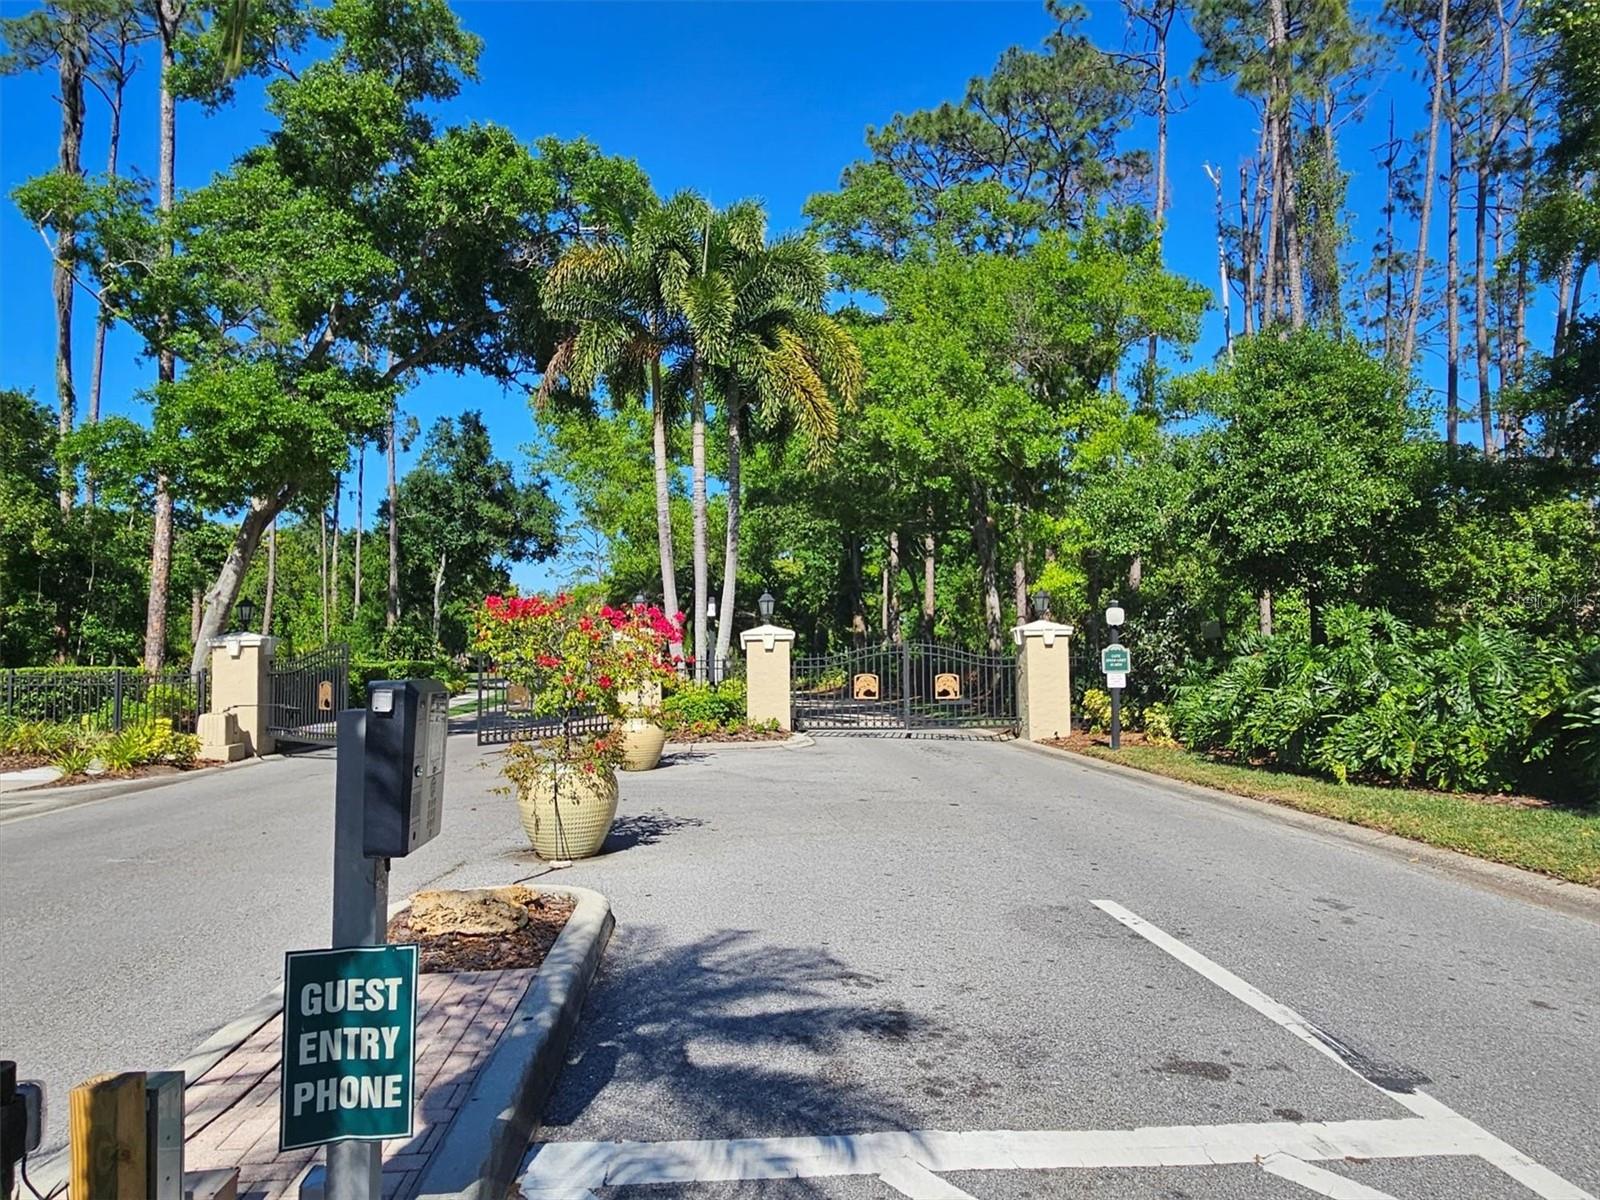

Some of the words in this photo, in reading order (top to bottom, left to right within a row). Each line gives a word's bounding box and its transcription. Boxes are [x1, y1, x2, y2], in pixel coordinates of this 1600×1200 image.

[300, 977, 403, 1017] GUEST
[299, 1025, 400, 1066] ENTRY
[293, 1074, 403, 1117] PHONE
